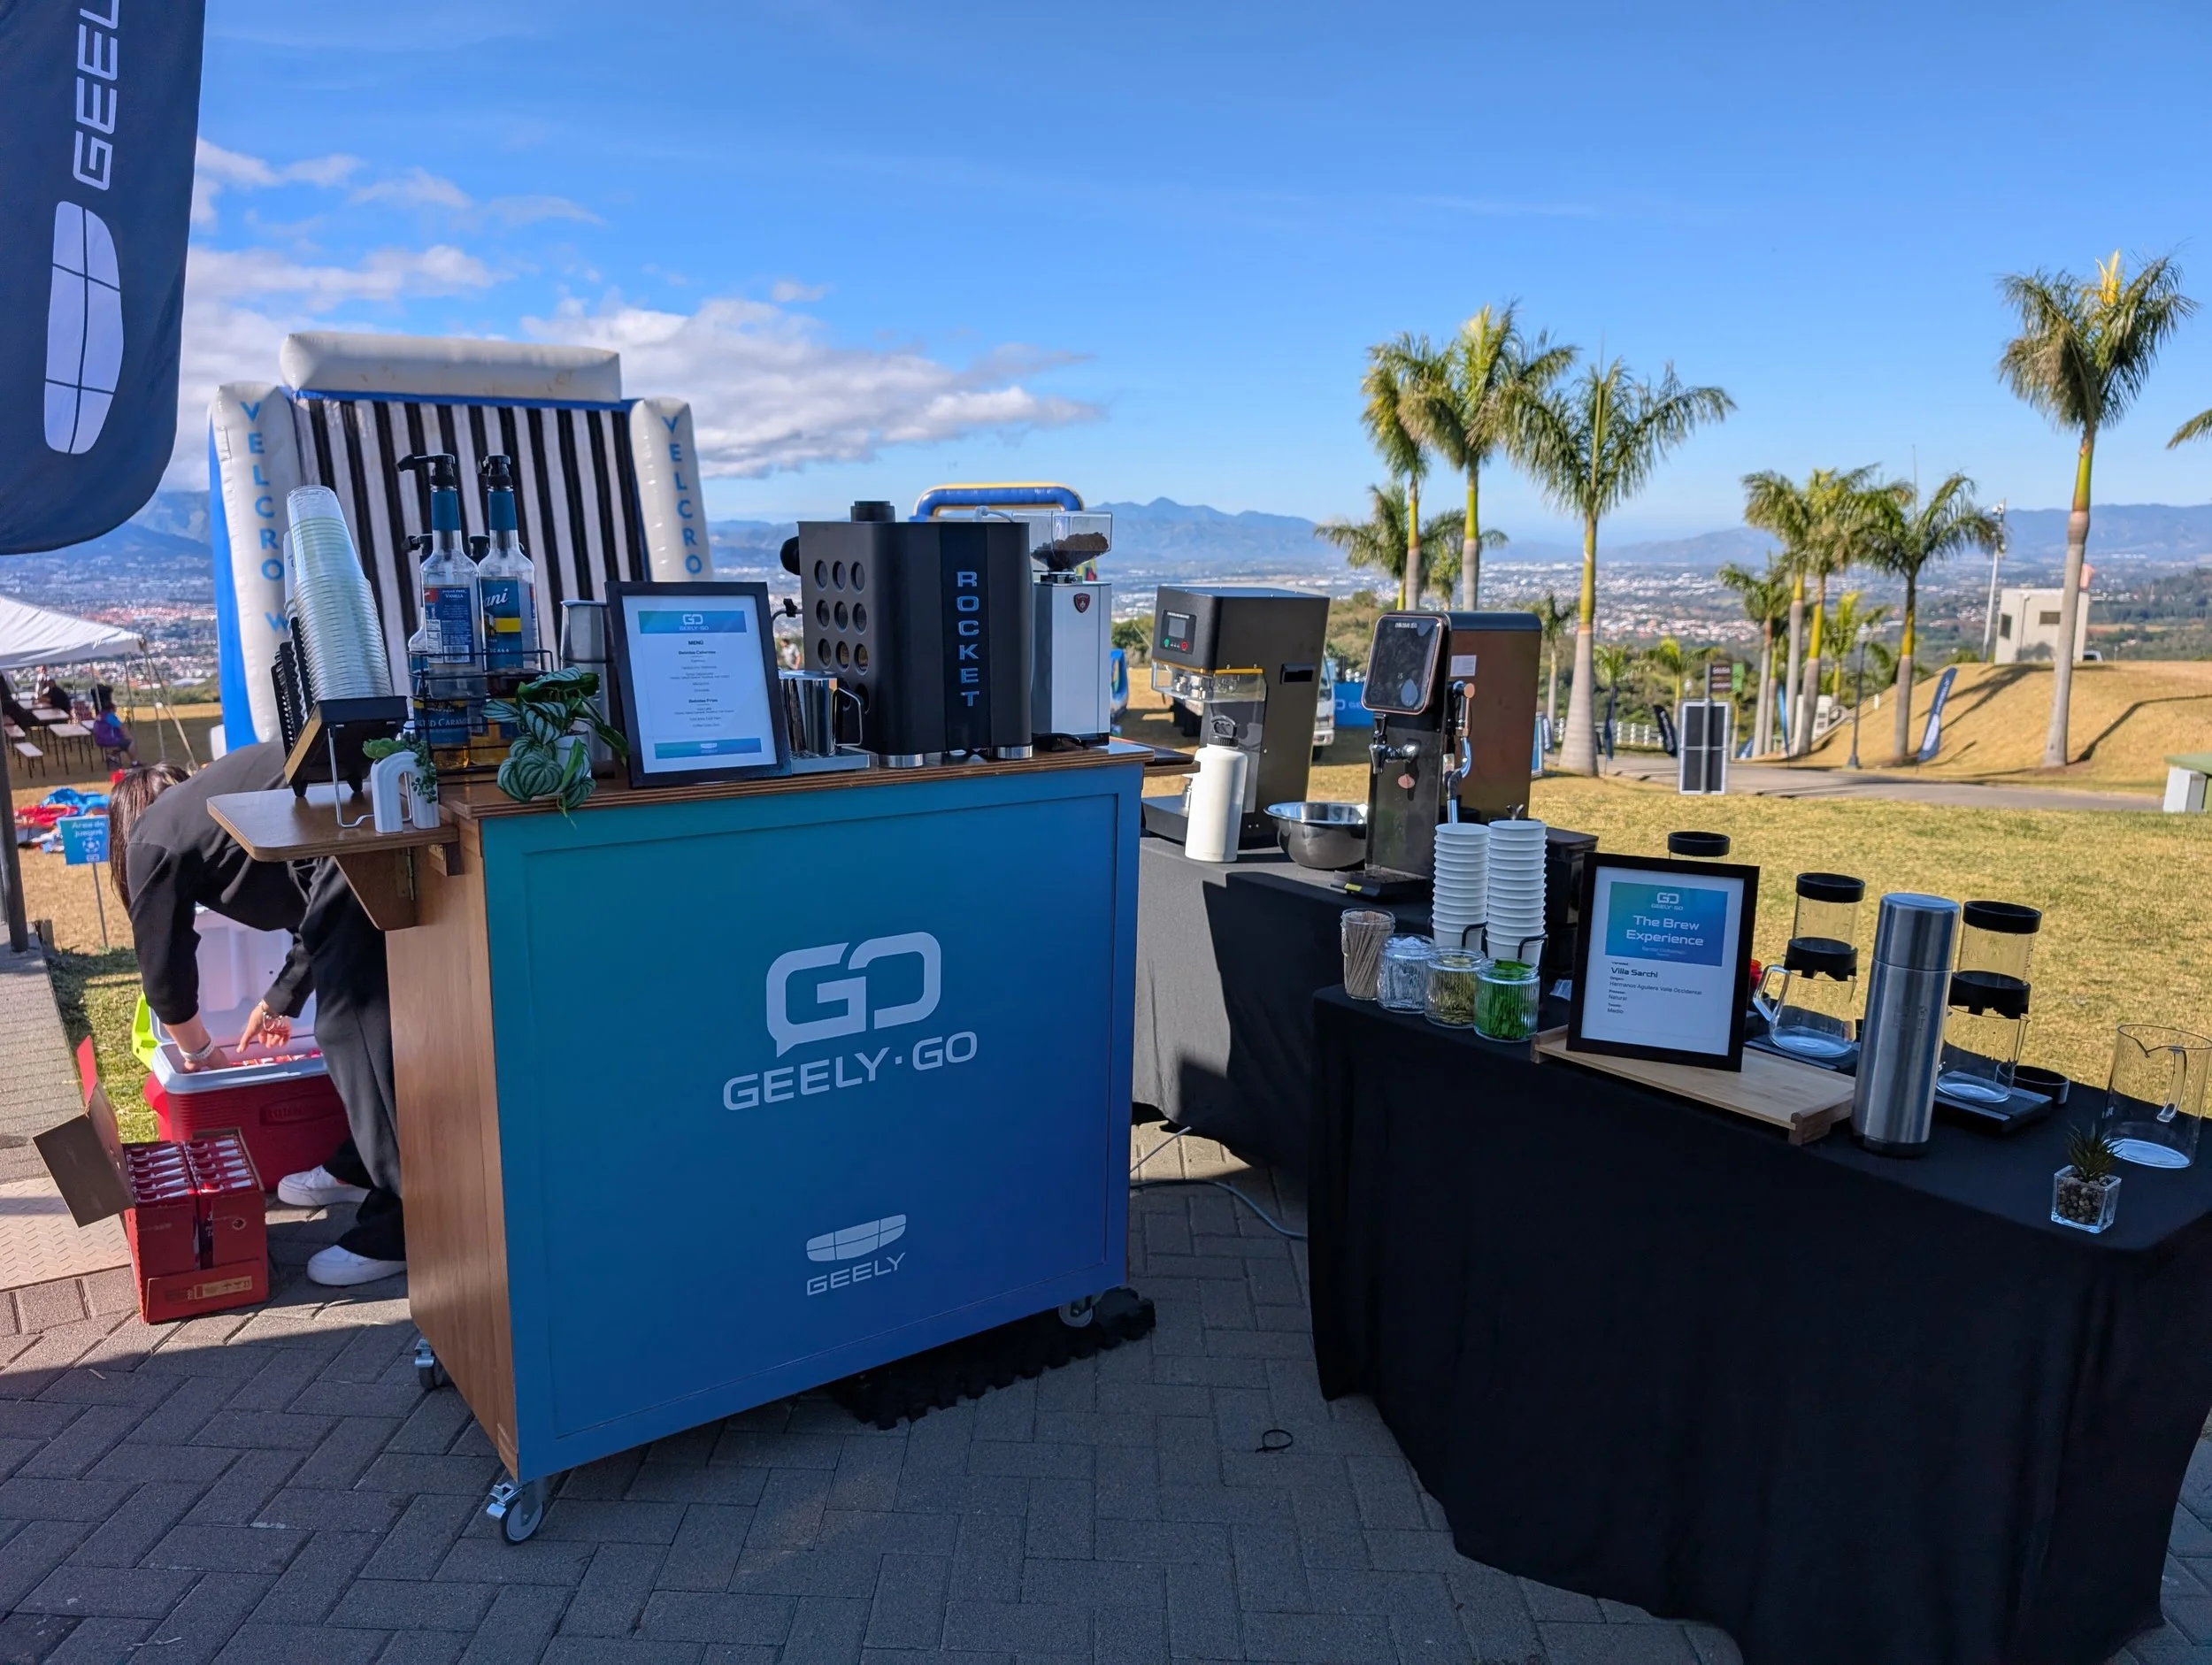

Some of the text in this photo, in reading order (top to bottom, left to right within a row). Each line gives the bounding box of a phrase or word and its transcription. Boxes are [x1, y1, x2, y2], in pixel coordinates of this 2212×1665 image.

[73, 0, 119, 191] GEEL
[240, 401, 285, 581] VELCRO
[662, 415, 703, 574] VELCRO
[482, 587, 509, 608] ani
[956, 572, 979, 707] ROCKET
[1626, 929, 1704, 946] Experience
[1632, 915, 1700, 931] The Brew
[766, 932, 941, 1058] GO
[806, 1252, 907, 1296] GEELY
